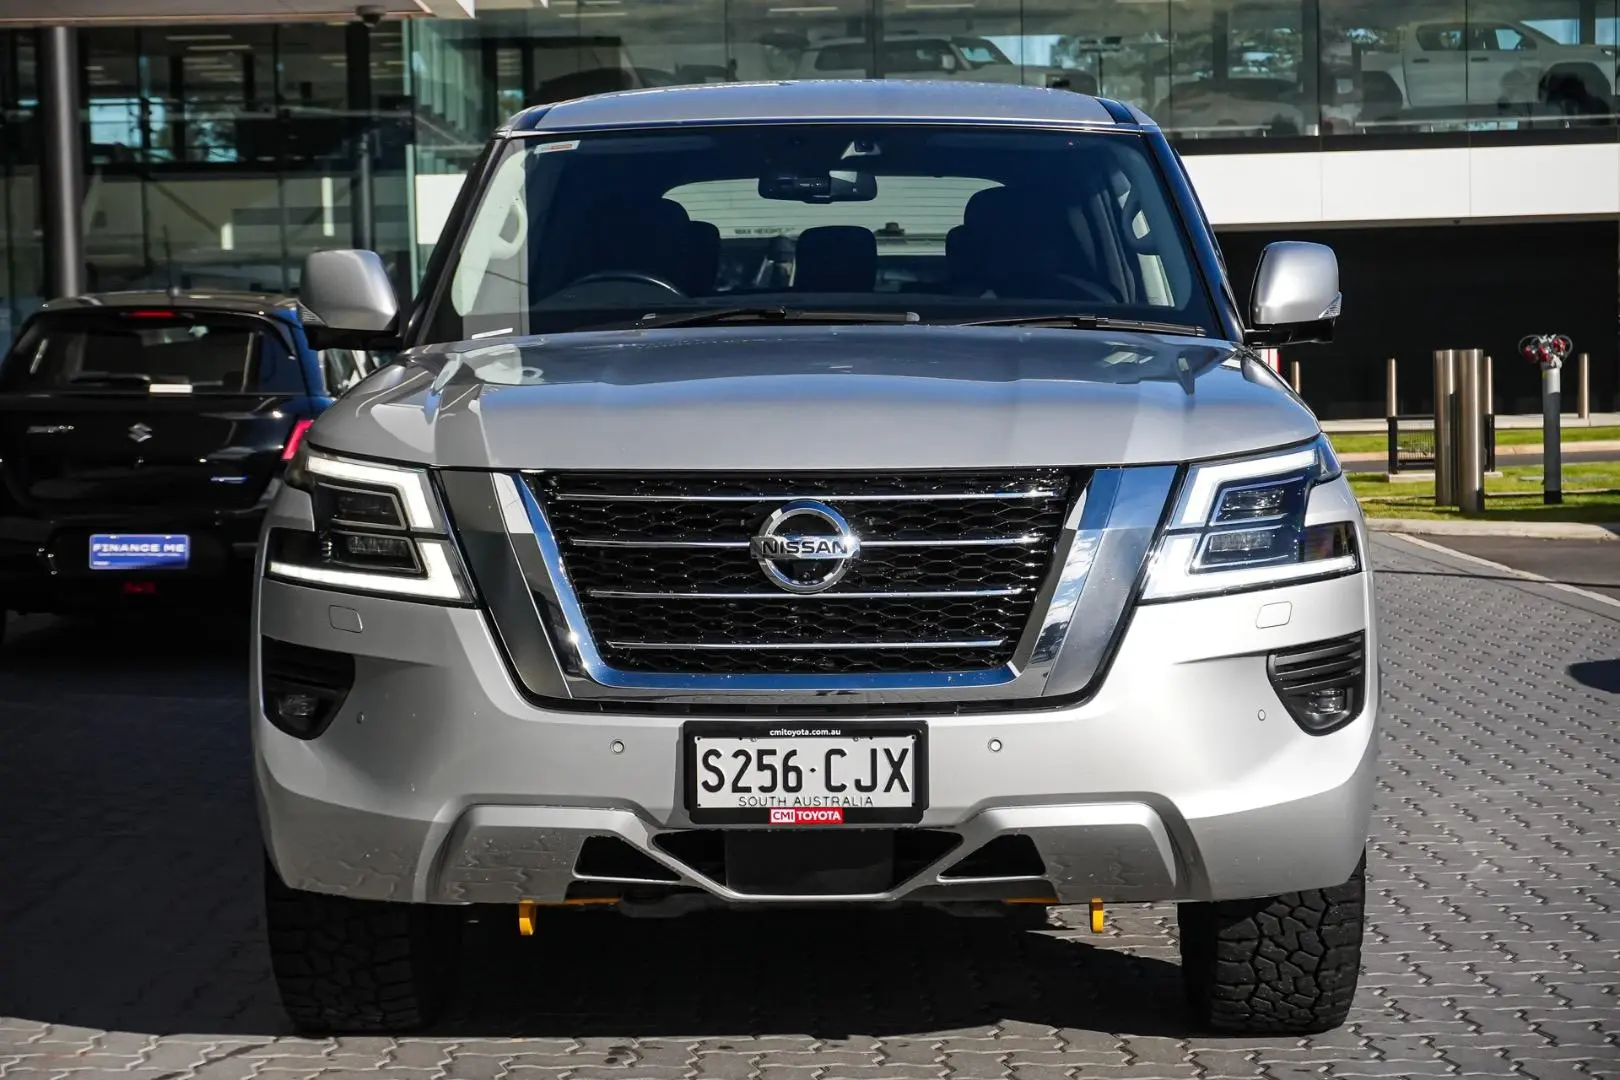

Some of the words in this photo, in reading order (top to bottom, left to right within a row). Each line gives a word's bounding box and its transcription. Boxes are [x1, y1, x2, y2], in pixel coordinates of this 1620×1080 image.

[93, 543, 160, 553] FINANCE
[163, 543, 184, 553] ME
[762, 540, 848, 554] NISSAN
[769, 728, 841, 737] cmitoyota.com.au
[738, 796, 787, 807] SOUTH
[793, 796, 874, 807] AUSTRALIA
[796, 811, 841, 821] TOYOTA
